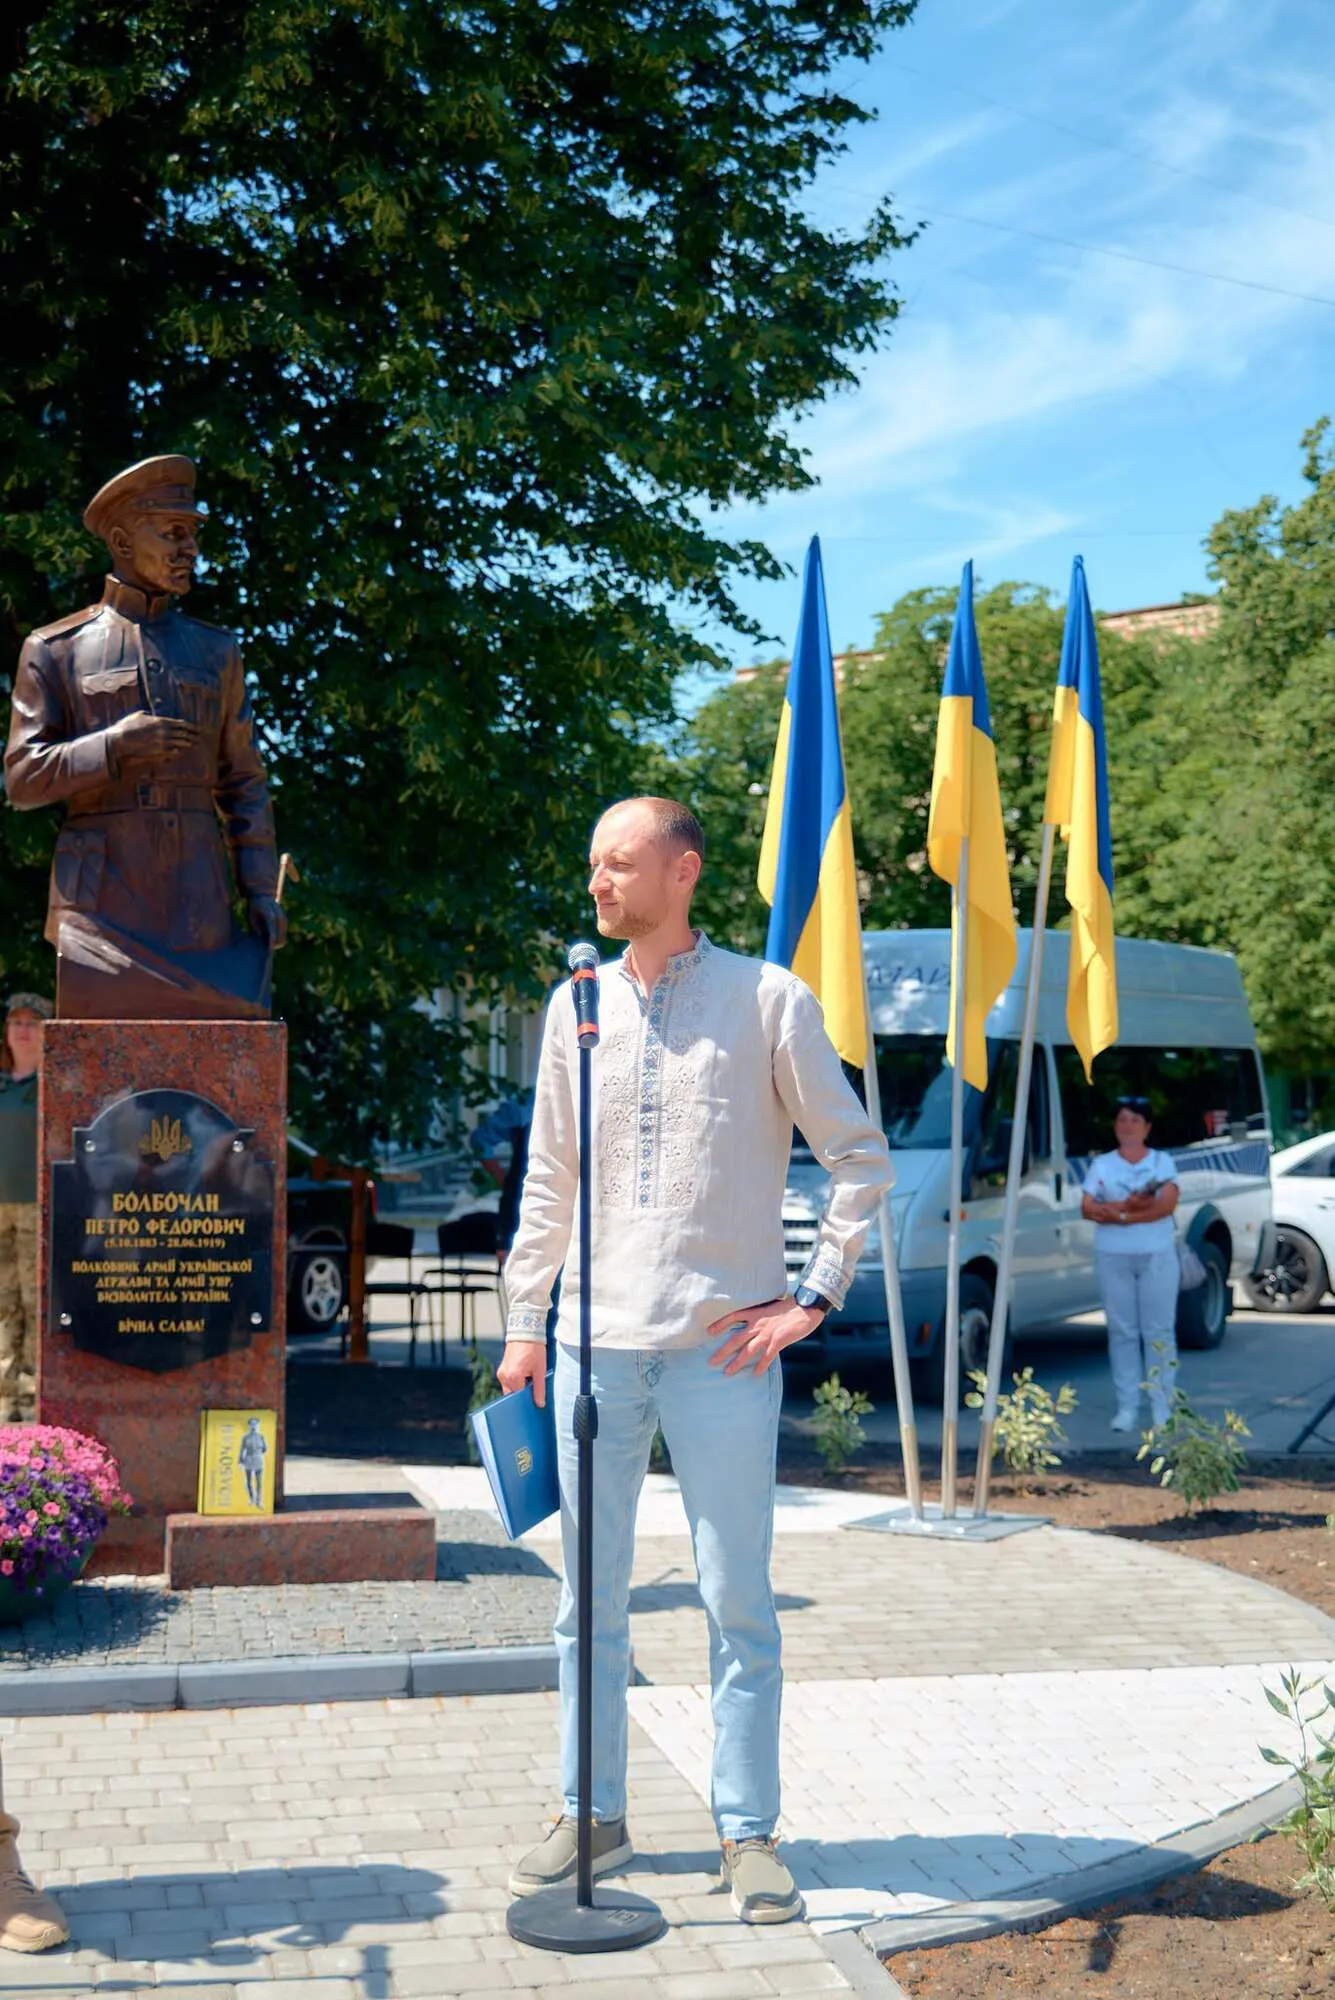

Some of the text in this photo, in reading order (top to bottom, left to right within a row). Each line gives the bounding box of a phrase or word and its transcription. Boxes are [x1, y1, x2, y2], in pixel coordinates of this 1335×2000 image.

[112, 1191, 220, 1213] БОЛБОЧАН
[85, 1217, 245, 1235] ПЕТРО ФЕДОРОВИЧ
[72, 1258, 252, 1273] ПОЛКОВНИК АРМІЇ УКРАЇНСЬКОЇ
[95, 1276, 151, 1288] ДЕРЖАВИ
[156, 1276, 169, 1288] ТА
[174, 1274, 205, 1288] АРМІЇ
[97, 1291, 177, 1303] ВИЗВОЛИТЕЛЬ
[118, 1317, 205, 1333] ВІЧНА СЛАВА!
